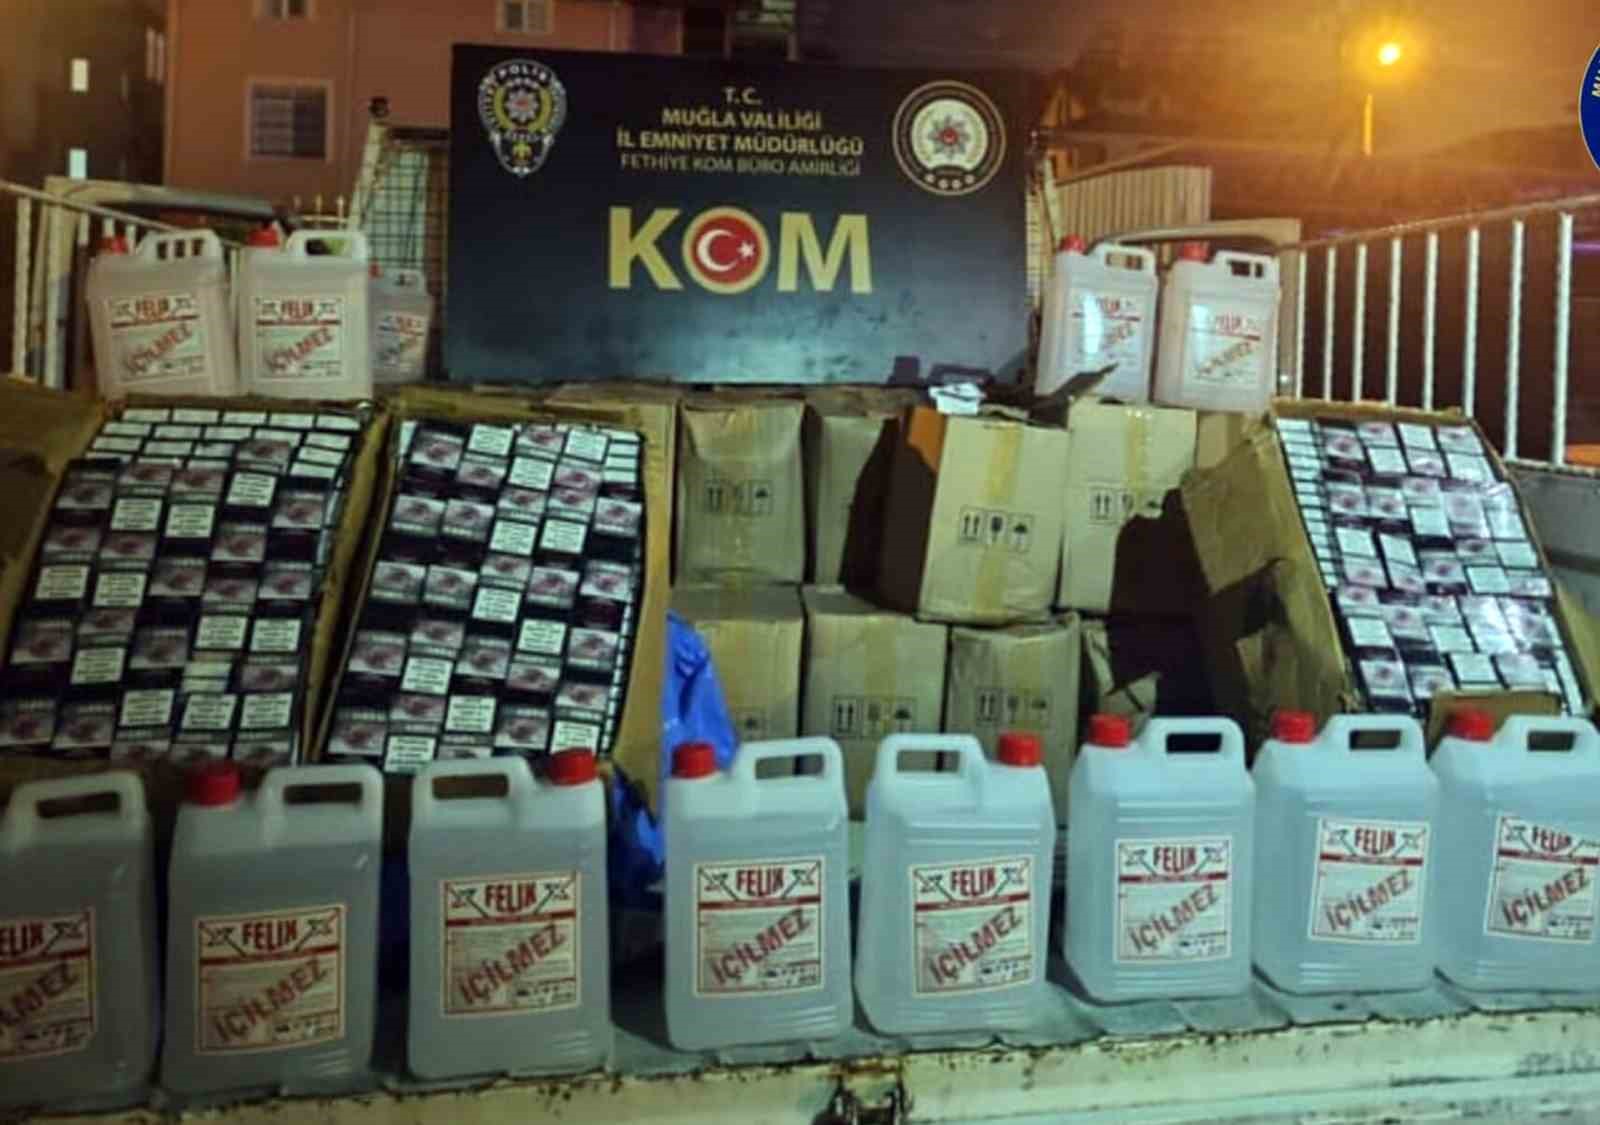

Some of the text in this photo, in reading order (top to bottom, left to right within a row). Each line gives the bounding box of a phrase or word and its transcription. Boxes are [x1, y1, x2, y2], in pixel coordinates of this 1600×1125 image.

[724, 87, 762, 105] T.C.
[661, 105, 822, 130] MUĞLA VALİLİĞİ
[616, 125, 864, 156] İL EMNİYET MÜDÜRLÜĞÜ
[608, 205, 873, 294] KOM
